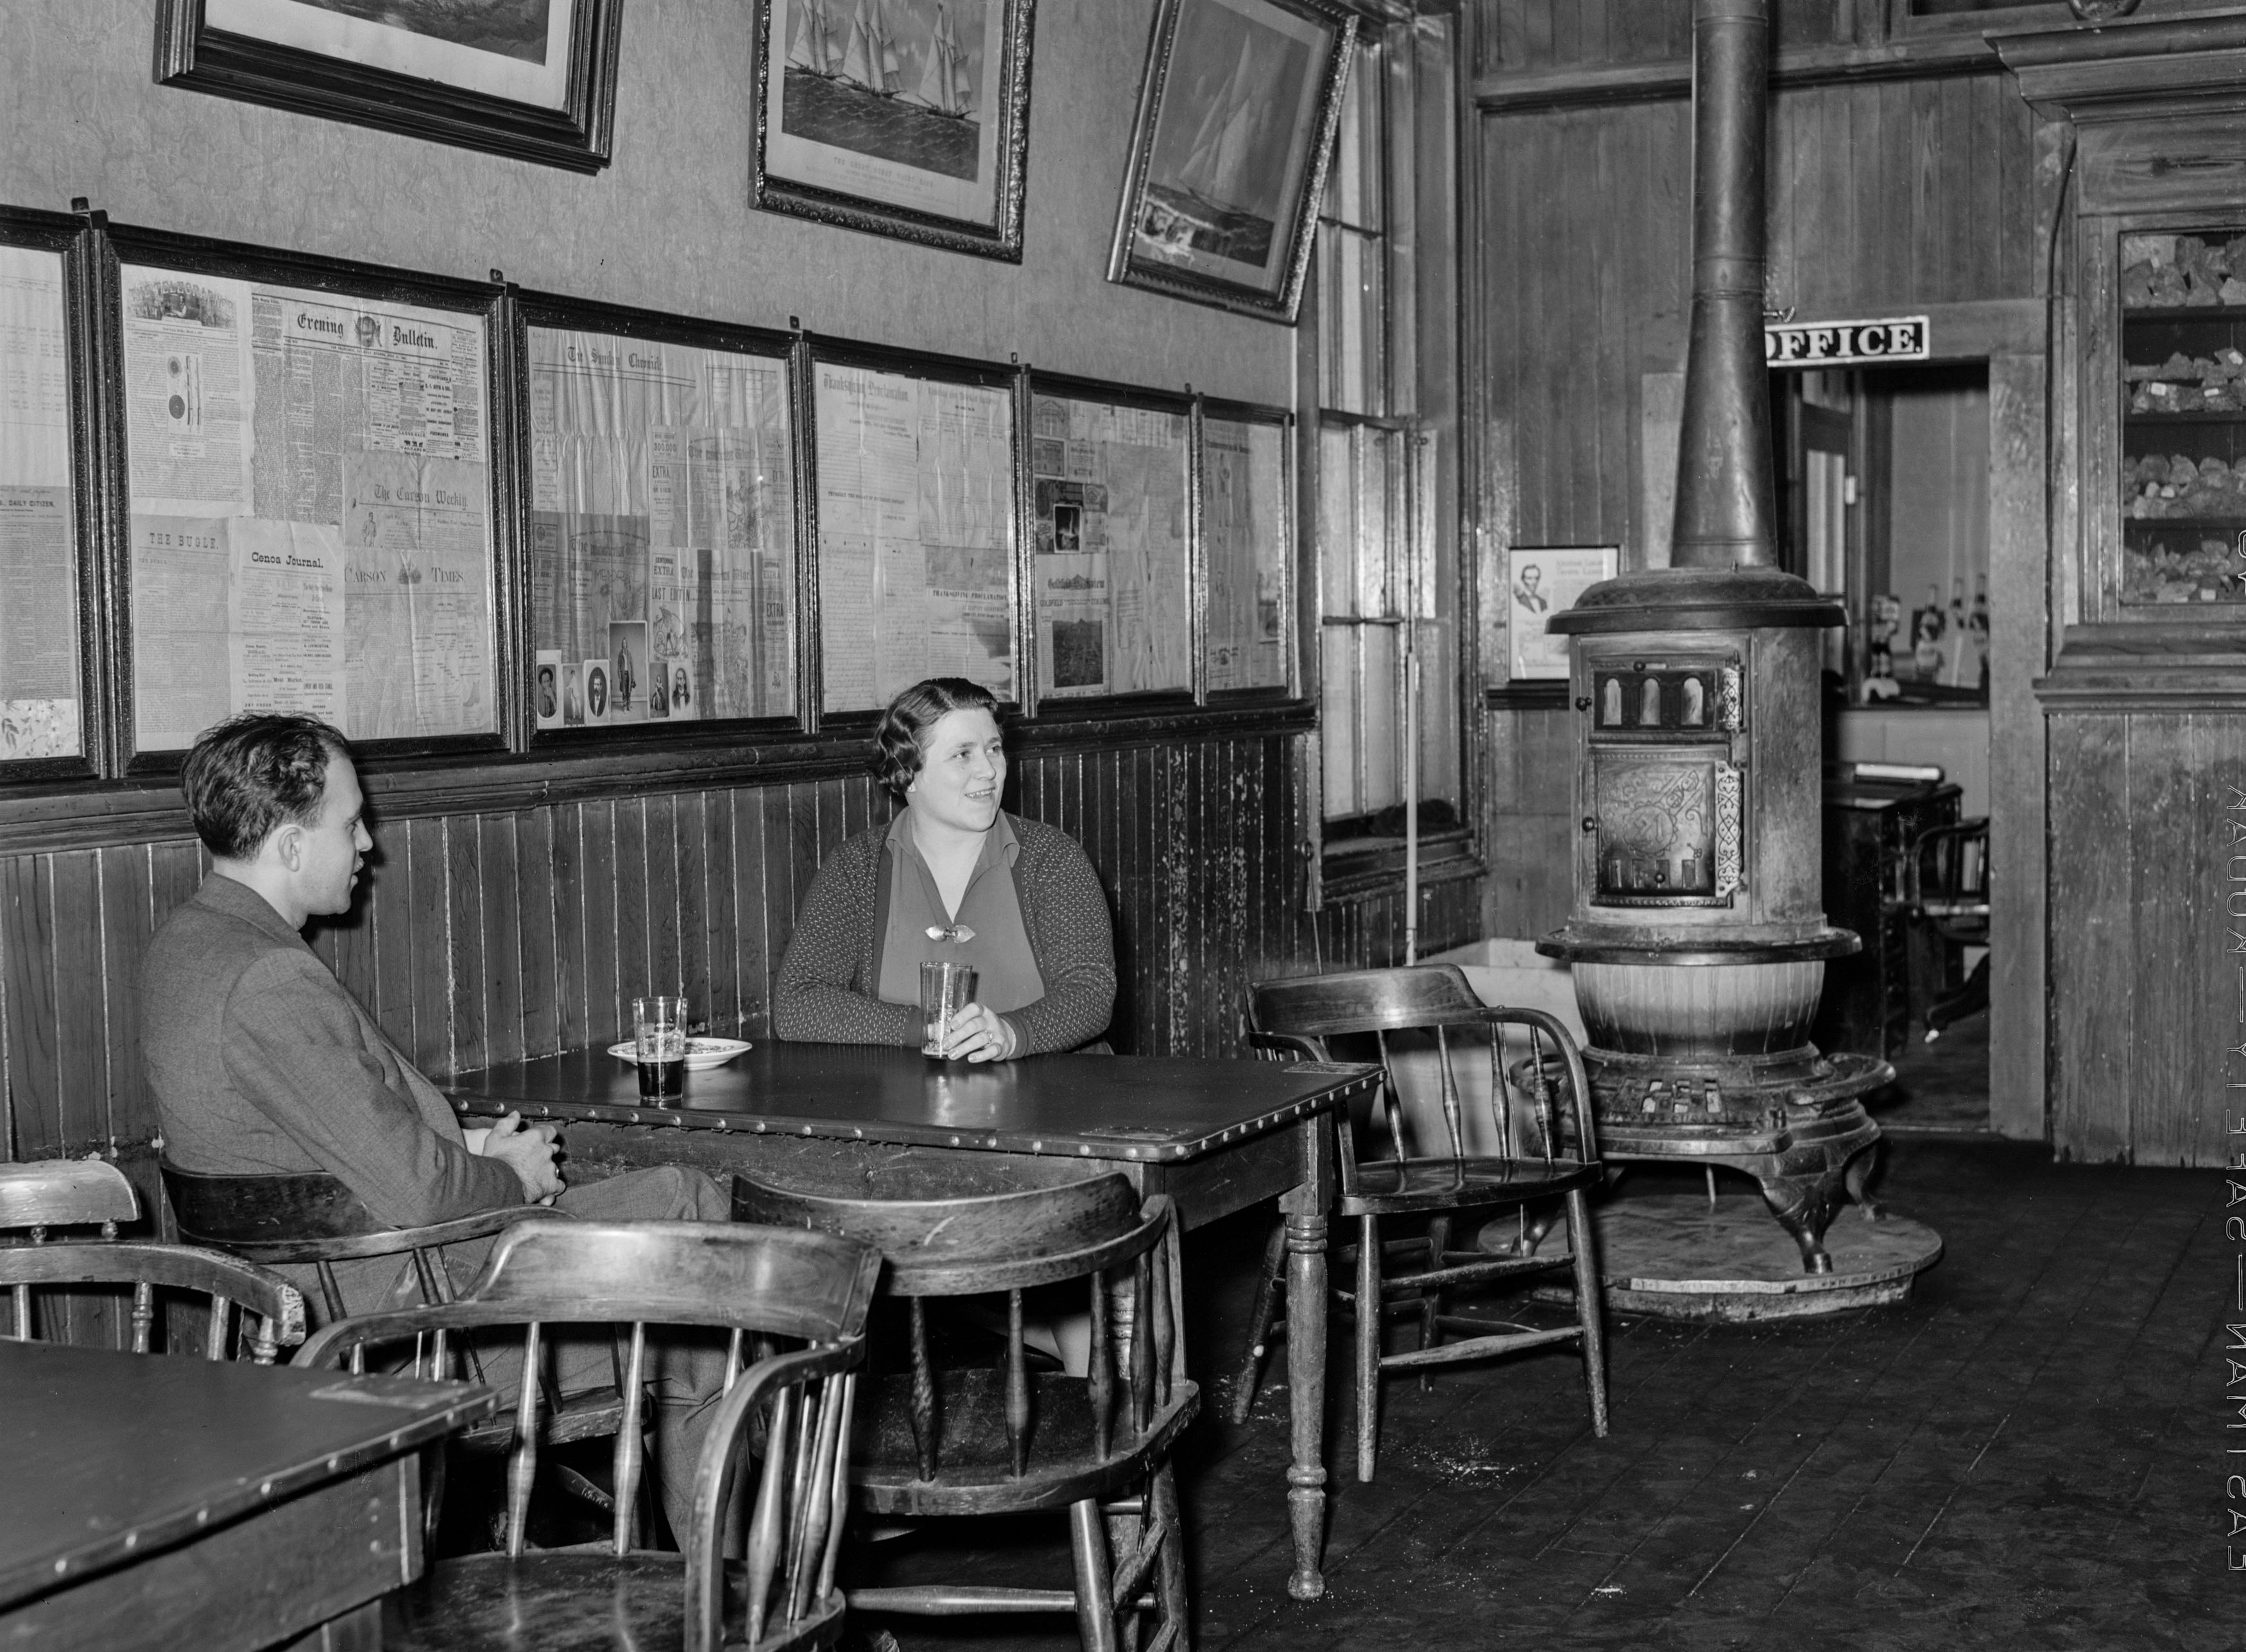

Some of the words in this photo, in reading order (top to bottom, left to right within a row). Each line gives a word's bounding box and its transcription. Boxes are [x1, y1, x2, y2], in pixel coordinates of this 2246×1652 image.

[393, 325, 438, 349] Bulletin.
[150, 532, 171, 546] THE
[178, 535, 220, 550] BUGLE.
[286, 555, 324, 569] Journal.
[652, 586, 666, 601] LAST
